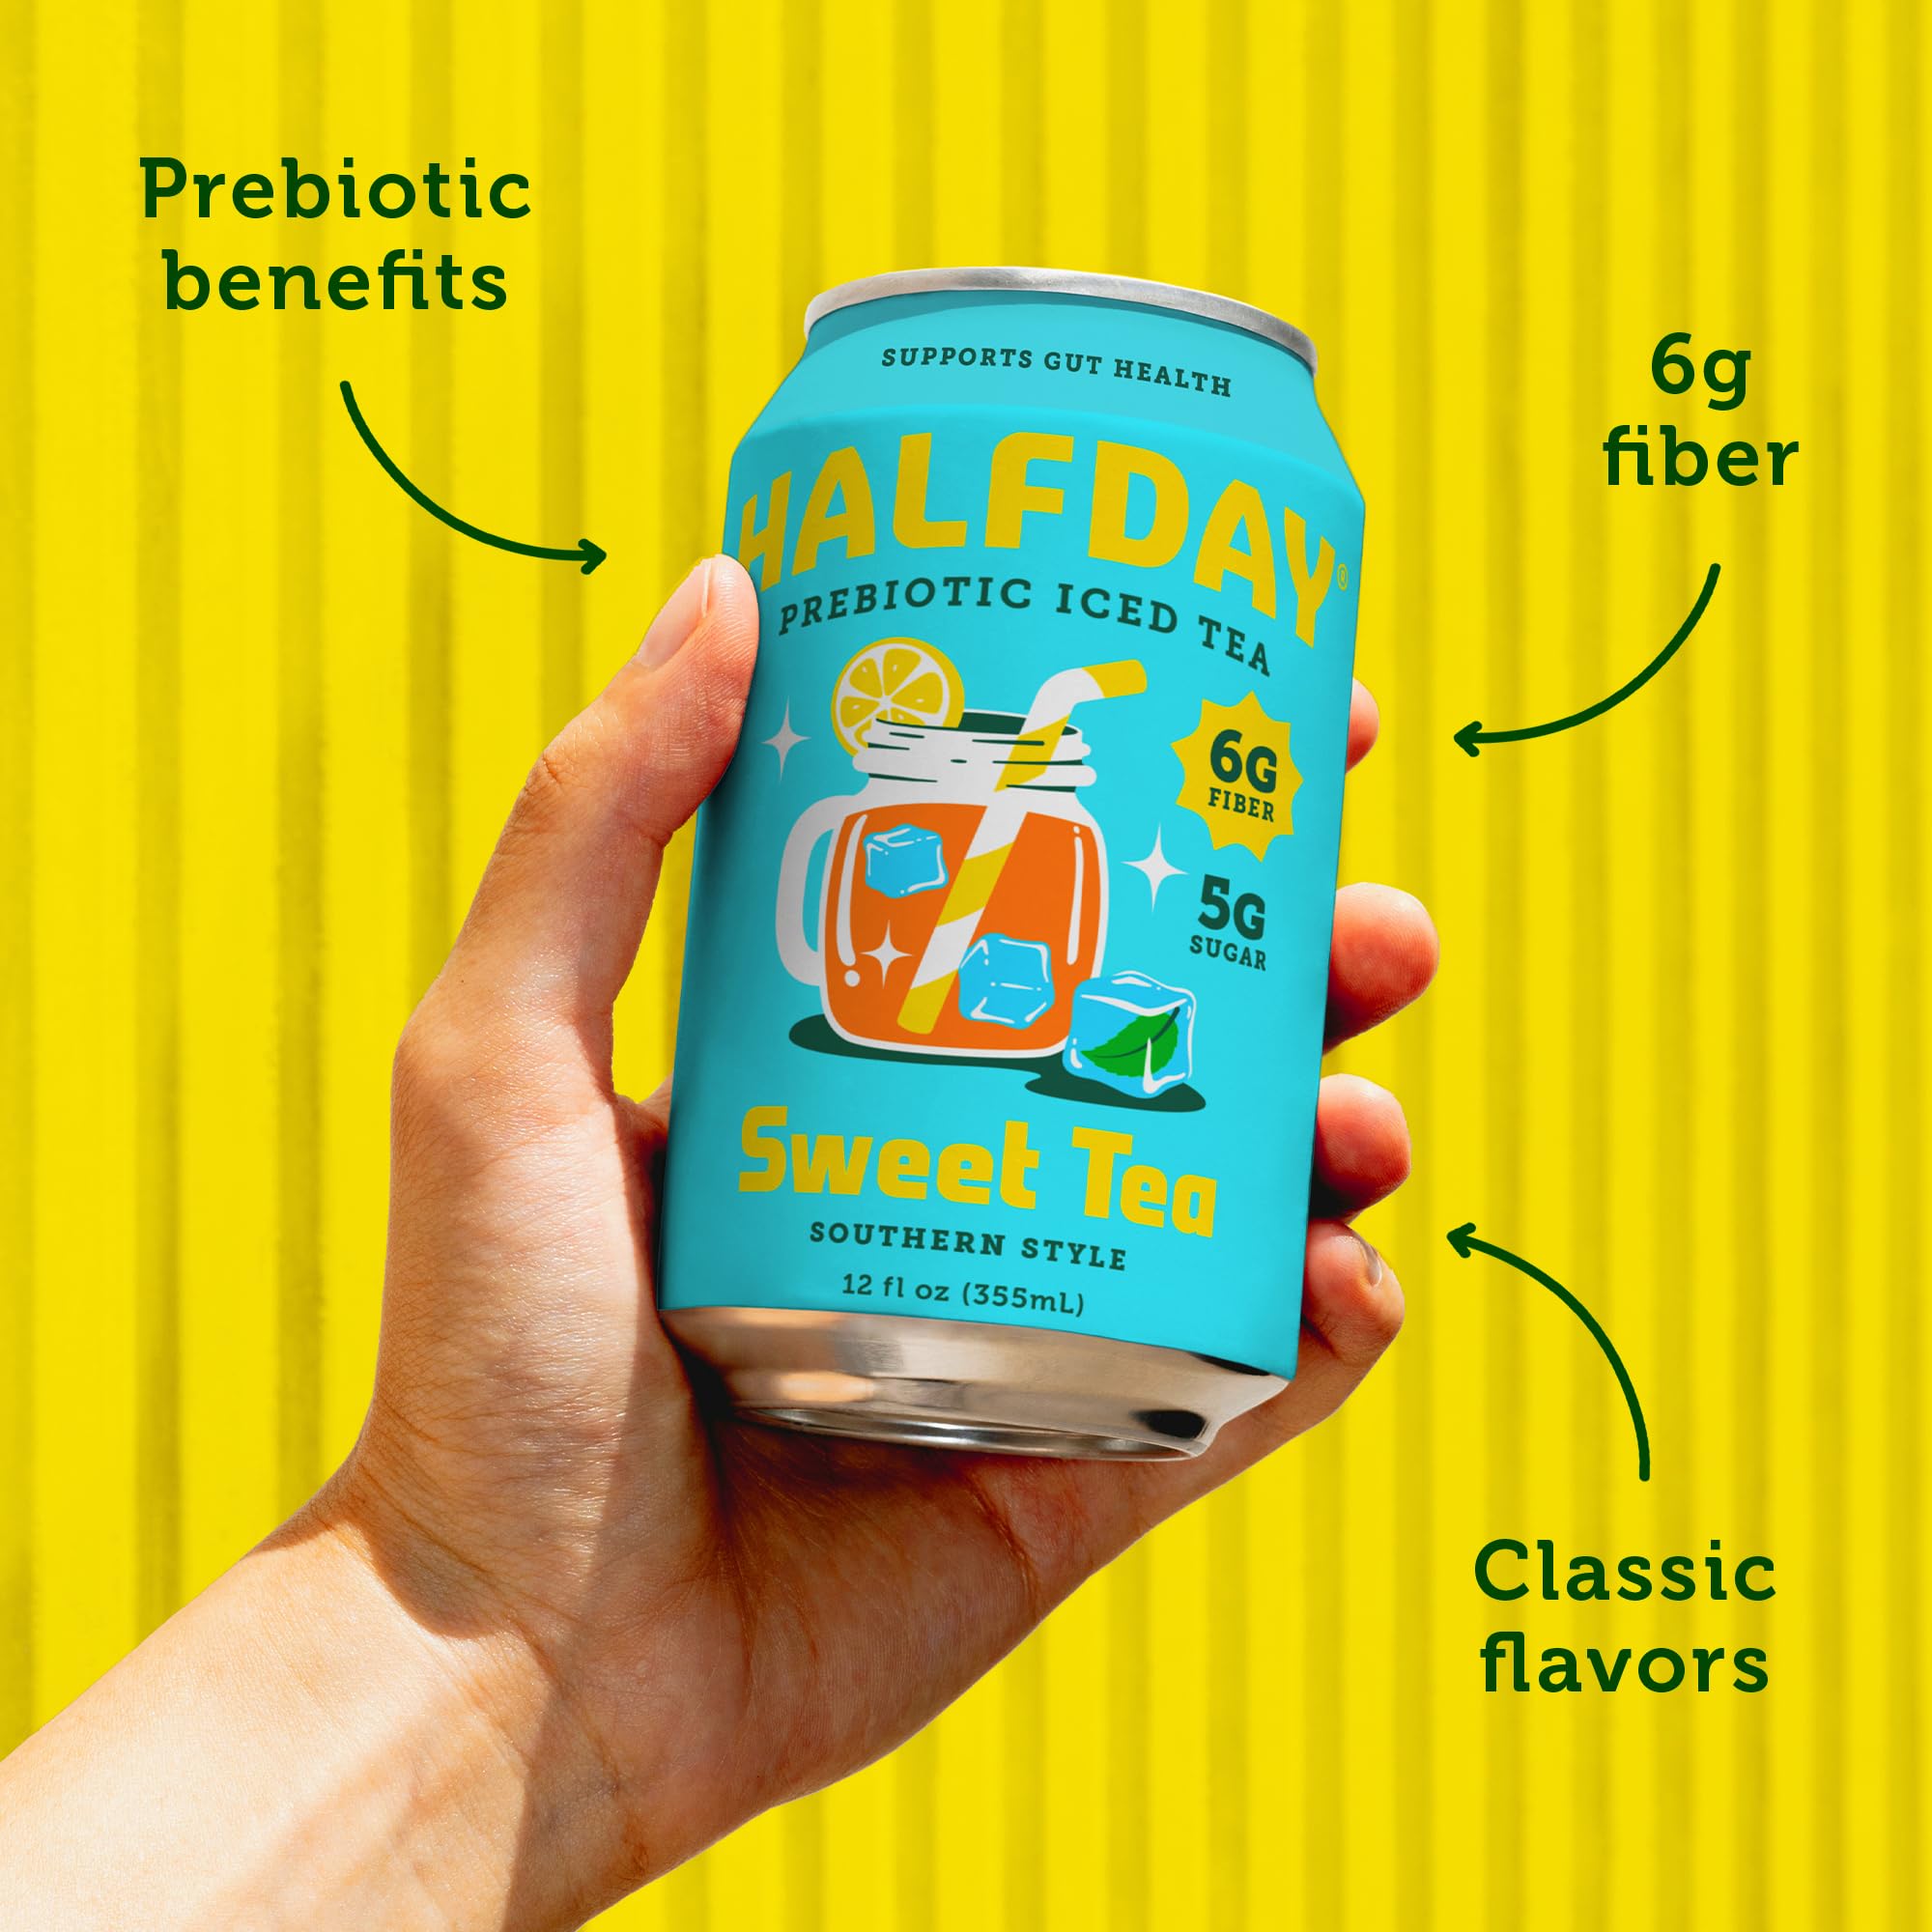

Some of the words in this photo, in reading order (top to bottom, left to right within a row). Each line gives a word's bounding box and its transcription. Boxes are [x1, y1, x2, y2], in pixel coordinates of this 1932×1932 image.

[881, 347, 1033, 369] SUPPORTS
[1043, 352, 1102, 375] GUT
[1114, 358, 1232, 398] HEALTH
[778, 576, 1032, 638] PREBIOTIC
[1056, 582, 1178, 634] ICED
[1198, 614, 1270, 677] TEA
[1209, 728, 1277, 794] 6G
[1208, 787, 1275, 823] FIBER
[1198, 873, 1265, 941] 5G
[1189, 933, 1266, 972] SUGAR
[739, 1105, 1039, 1209] Sweet
[1071, 1126, 1217, 1238] Tea
[810, 1221, 1006, 1257] SOUTHERN
[1021, 1237, 1127, 1271] STYLE
[842, 1273, 873, 1295] 12
[883, 1276, 904, 1298] fl
[915, 1284, 950, 1302] oz
[962, 1282, 1085, 1318] (355mL)
